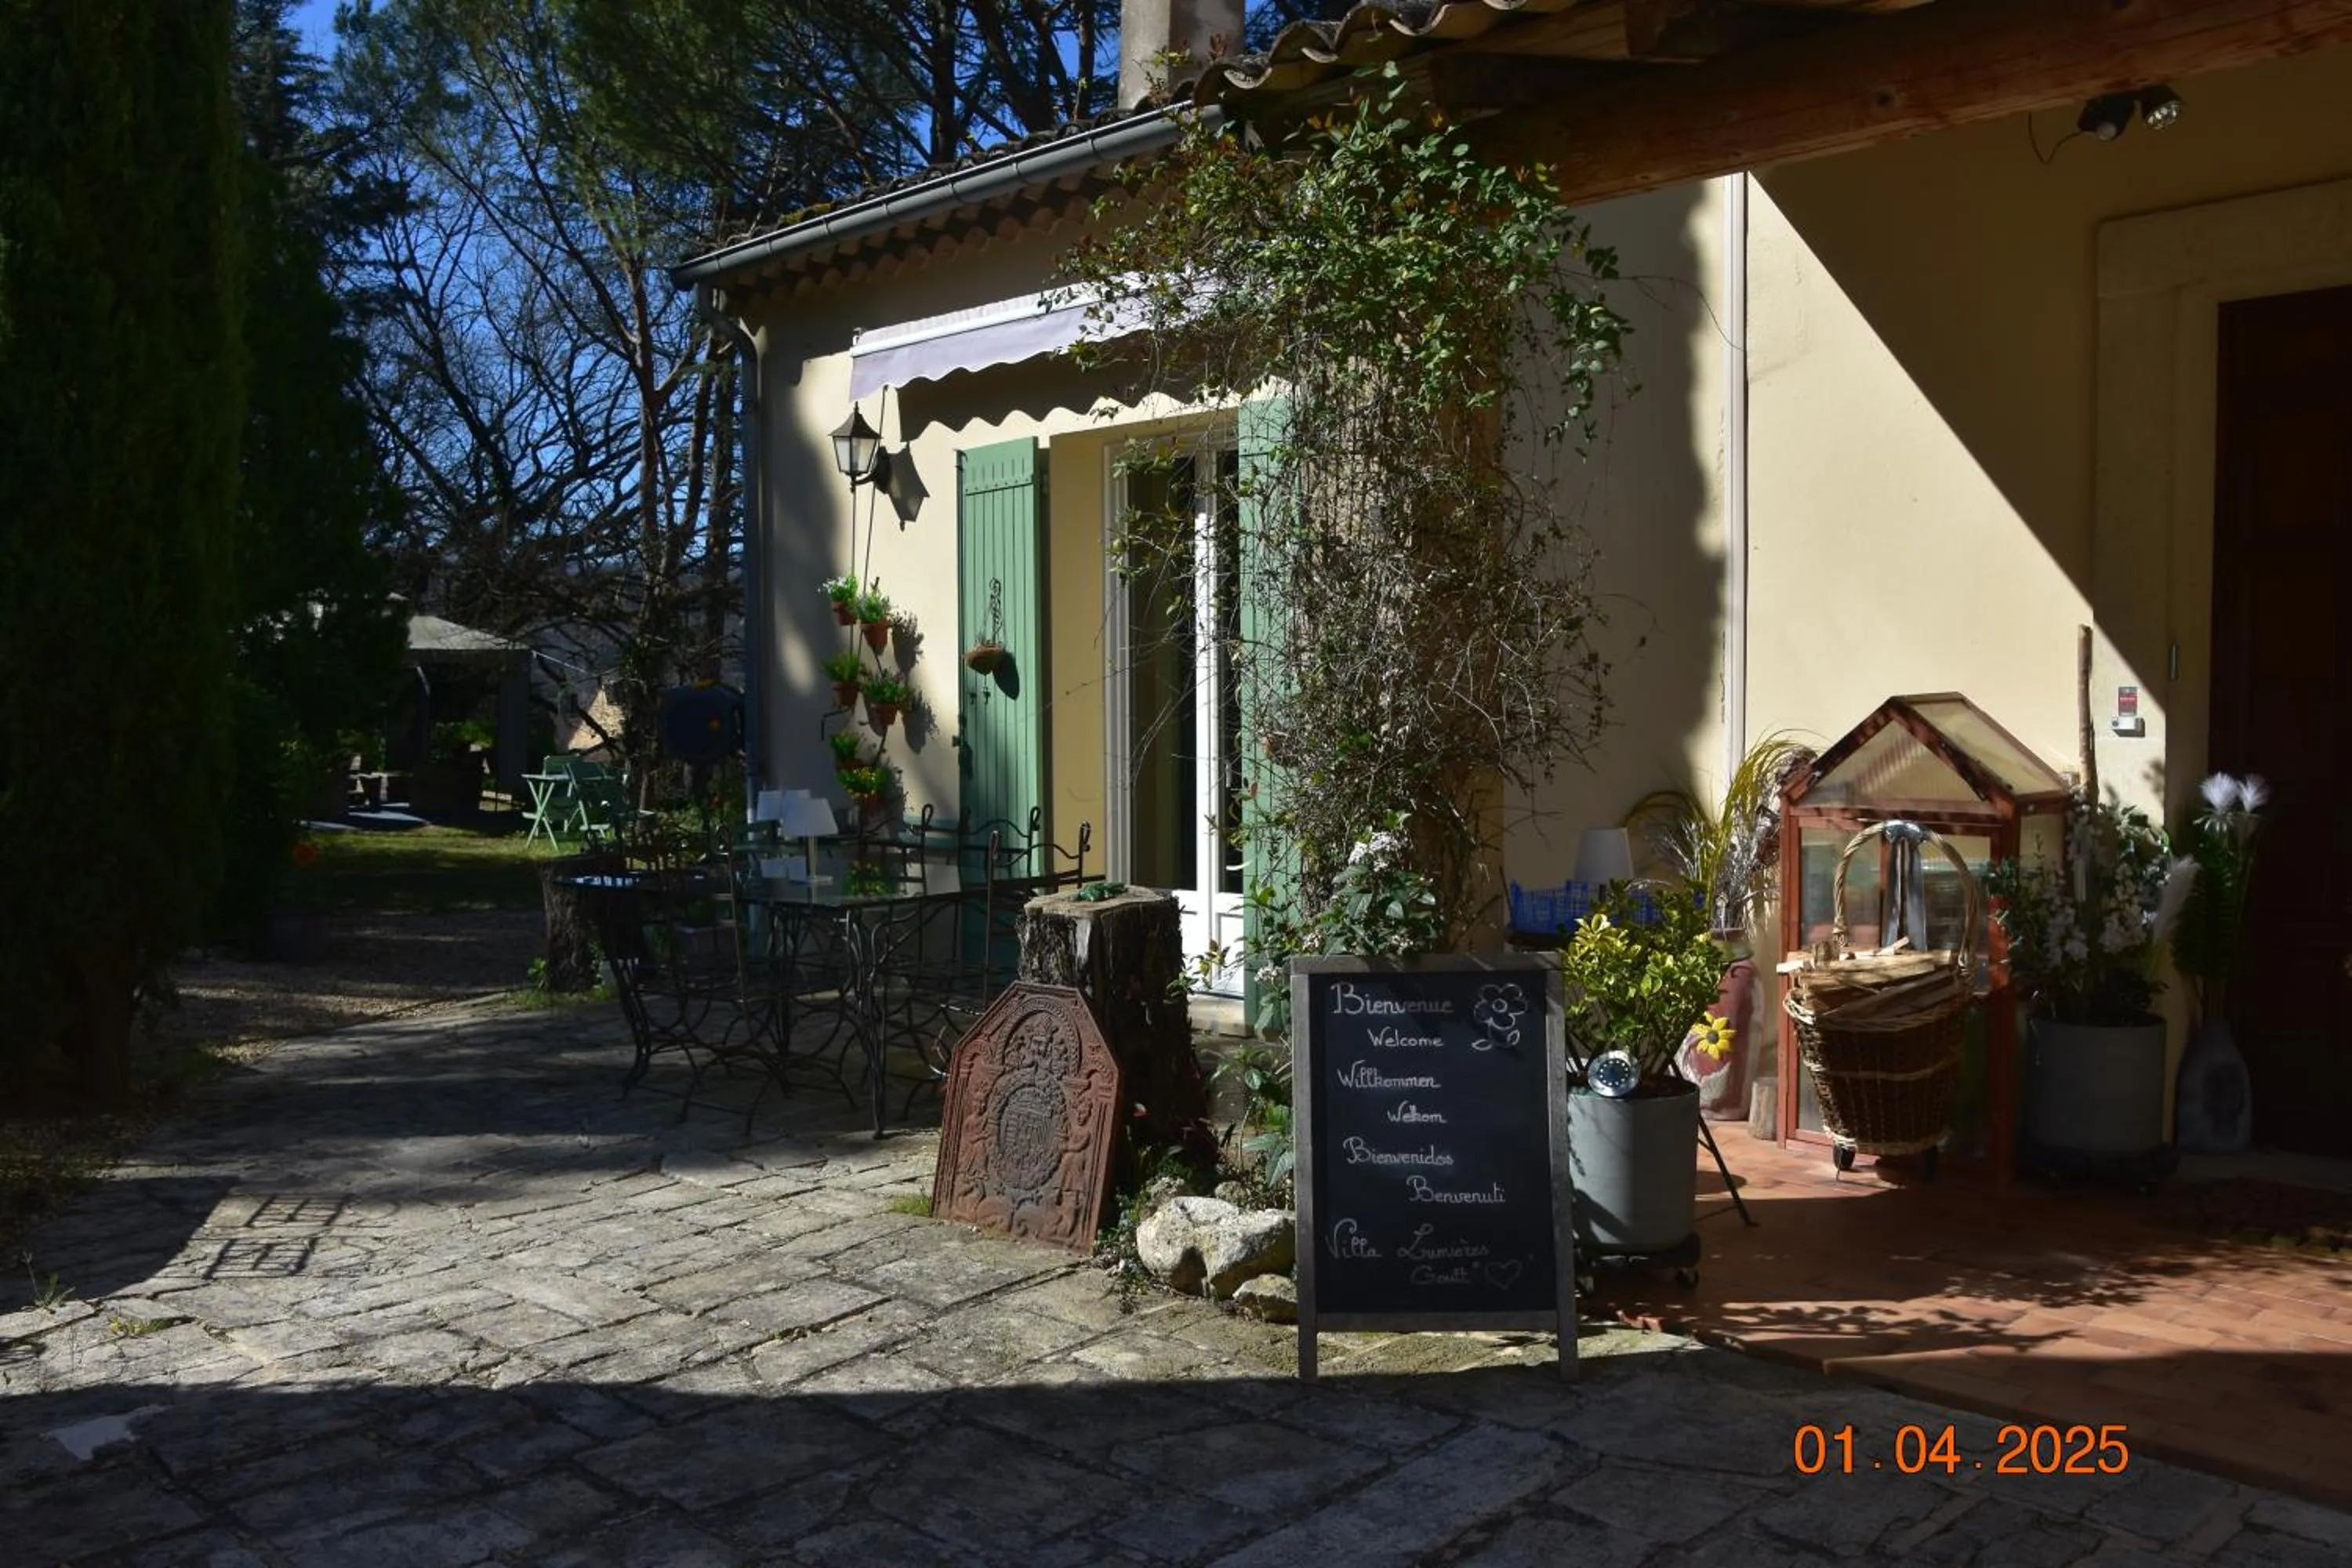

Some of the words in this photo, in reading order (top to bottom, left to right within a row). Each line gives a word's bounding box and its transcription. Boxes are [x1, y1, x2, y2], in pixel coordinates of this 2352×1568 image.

[1330, 982, 1454, 1014] Bienvenue
[1367, 1026, 1443, 1047] Welcome
[1338, 1060, 1441, 1088] Willkommen
[1343, 1136, 1454, 1166] Bienvenidos
[1406, 1175, 1505, 1203] Benvenuti
[1325, 1218, 1381, 1258] Villa
